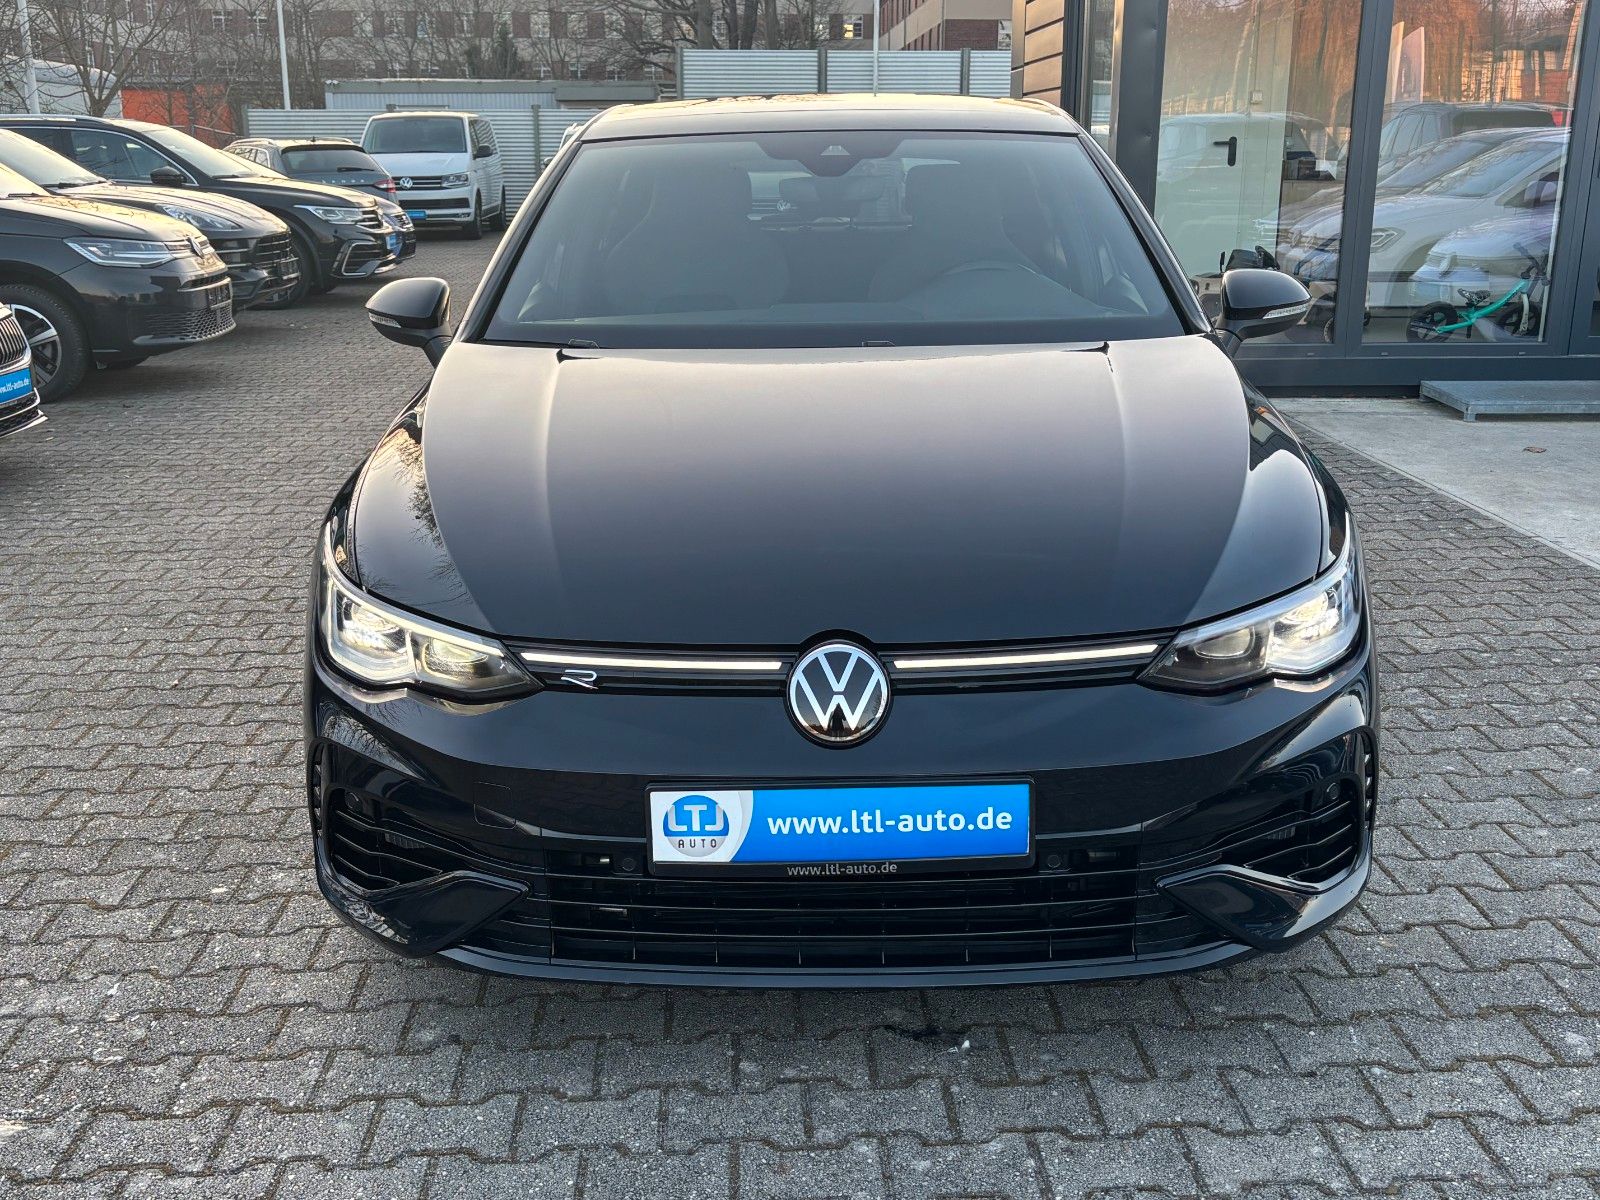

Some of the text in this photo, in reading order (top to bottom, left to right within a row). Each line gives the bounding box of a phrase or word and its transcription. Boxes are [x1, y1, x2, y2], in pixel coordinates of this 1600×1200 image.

[789, 644, 888, 742] VW
[767, 806, 1013, 835] www.ltl-auto.de
[678, 838, 717, 849] AUTO
[787, 862, 898, 876] www.ltl-auto.de
